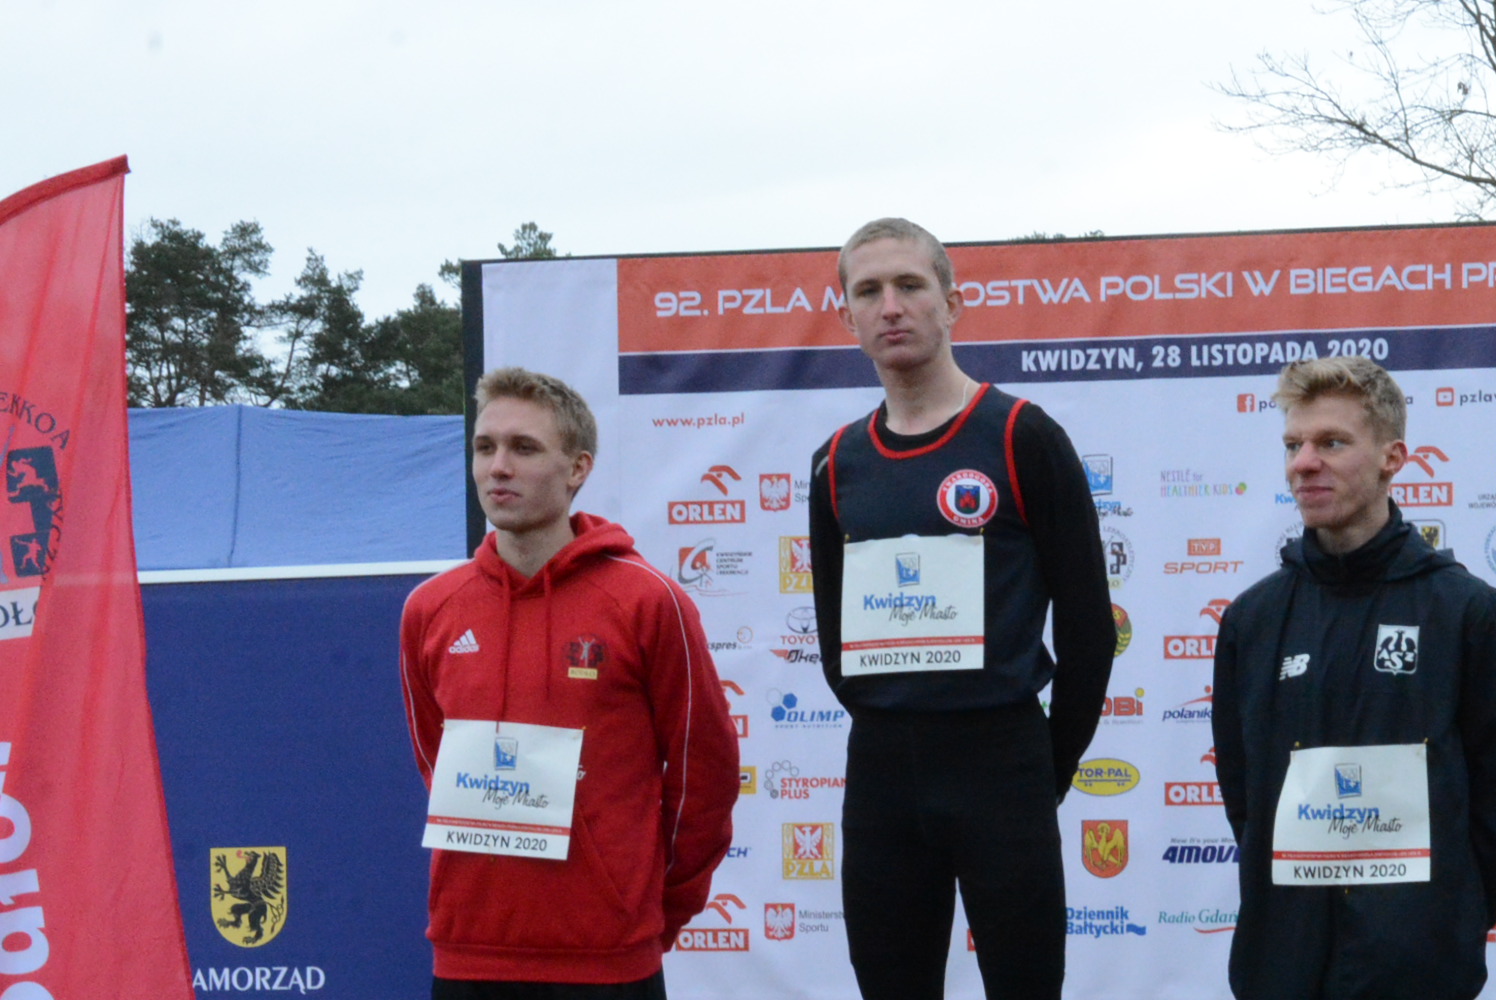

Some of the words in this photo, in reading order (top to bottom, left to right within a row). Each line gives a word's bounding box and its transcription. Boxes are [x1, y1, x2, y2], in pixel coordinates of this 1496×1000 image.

[654, 290, 710, 318] 92.
[718, 287, 812, 316] PZLA
[1100, 271, 1234, 302] POLSKI
[1242, 269, 1281, 296] W
[1290, 263, 1452, 294] BIEGACH
[1021, 346, 1143, 373] KWIDZYN,
[1152, 345, 1181, 369] 28
[1191, 340, 1318, 368] LISTOPADA
[1327, 337, 1389, 362] 2020
[652, 412, 745, 429] www.pzla.pl
[1393, 484, 1450, 505] RLEN
[671, 502, 742, 522] ORLEN
[1163, 560, 1245, 575] SPORT
[863, 592, 937, 612] Kwidzyn
[889, 606, 916, 627] Moje
[918, 604, 959, 622] Miasto
[779, 634, 818, 645] TOYO
[860, 651, 921, 668] KWIDZYN
[925, 649, 961, 664] 2020
[785, 709, 845, 722] OLIMP
[456, 771, 531, 797] Kwidzyn
[780, 788, 810, 799] PLUS
[483, 787, 510, 810] Moje
[512, 790, 549, 809] Miasto
[1168, 784, 1222, 804] ORLE
[1297, 802, 1380, 823] Kwidzyn
[1328, 817, 1358, 840] Moje
[1361, 815, 1403, 834] Miasto
[446, 830, 511, 849] KWIDZYN
[514, 836, 548, 852] 2020
[784, 860, 832, 877] PZLA
[1293, 864, 1364, 879] KWIDZYN
[1369, 863, 1407, 878] 2020
[799, 909, 845, 919] Ministerst
[1065, 907, 1129, 921] Dziennik
[1157, 911, 1196, 924] Radio
[1198, 908, 1239, 924] Gdań
[799, 922, 829, 933] Sportu
[1065, 921, 1125, 938] Bałtycki
[678, 931, 745, 949] ORLEN
[193, 966, 326, 995] AMORZĄD
